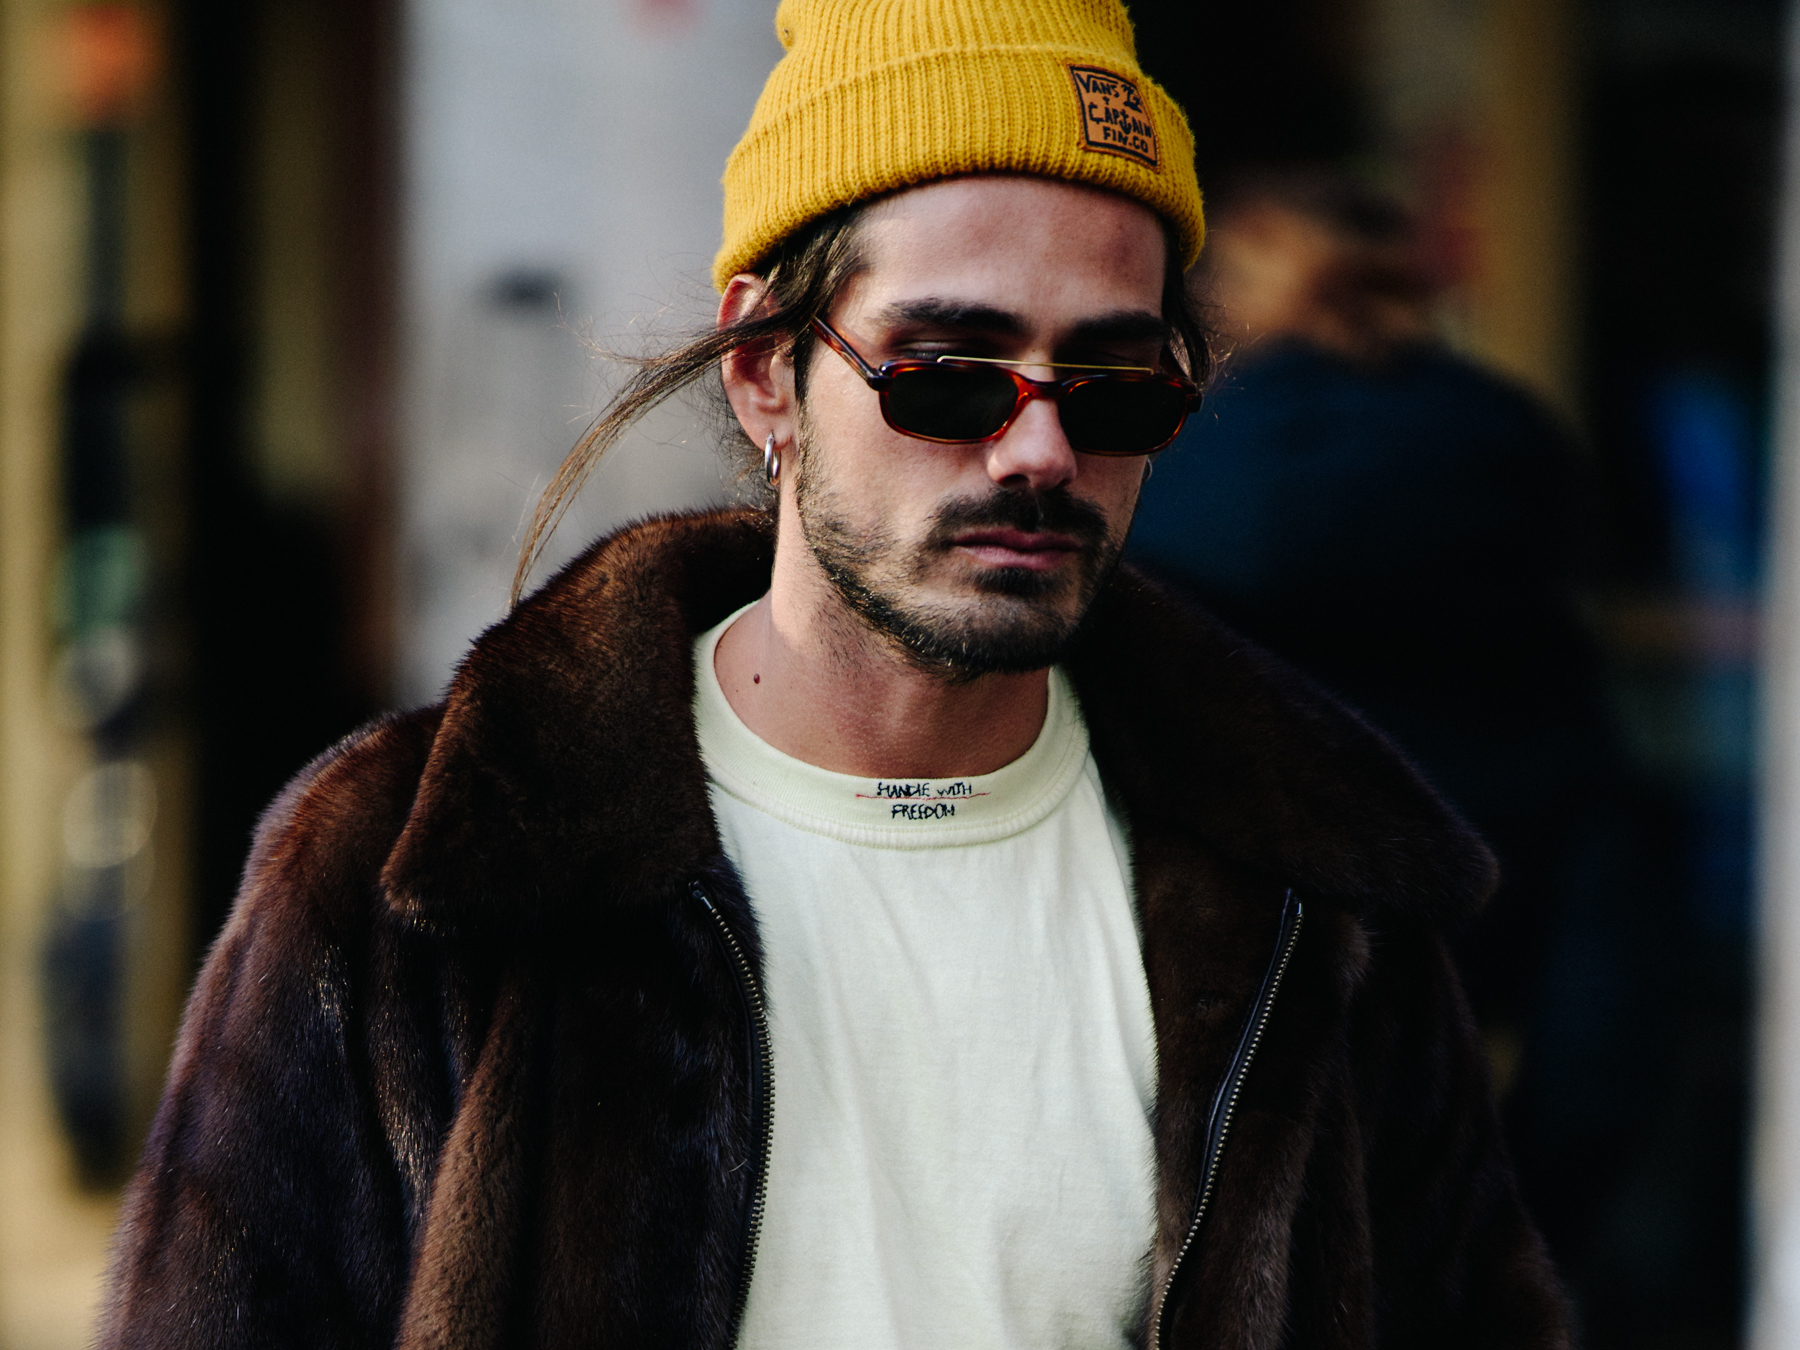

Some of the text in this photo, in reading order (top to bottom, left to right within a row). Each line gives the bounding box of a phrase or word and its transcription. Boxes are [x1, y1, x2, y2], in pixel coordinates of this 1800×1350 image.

[1074, 73, 1119, 98] VANS
[1088, 102, 1152, 138] CAPTAIN
[937, 781, 972, 796] WITH
[891, 803, 955, 820] FREEDOM
